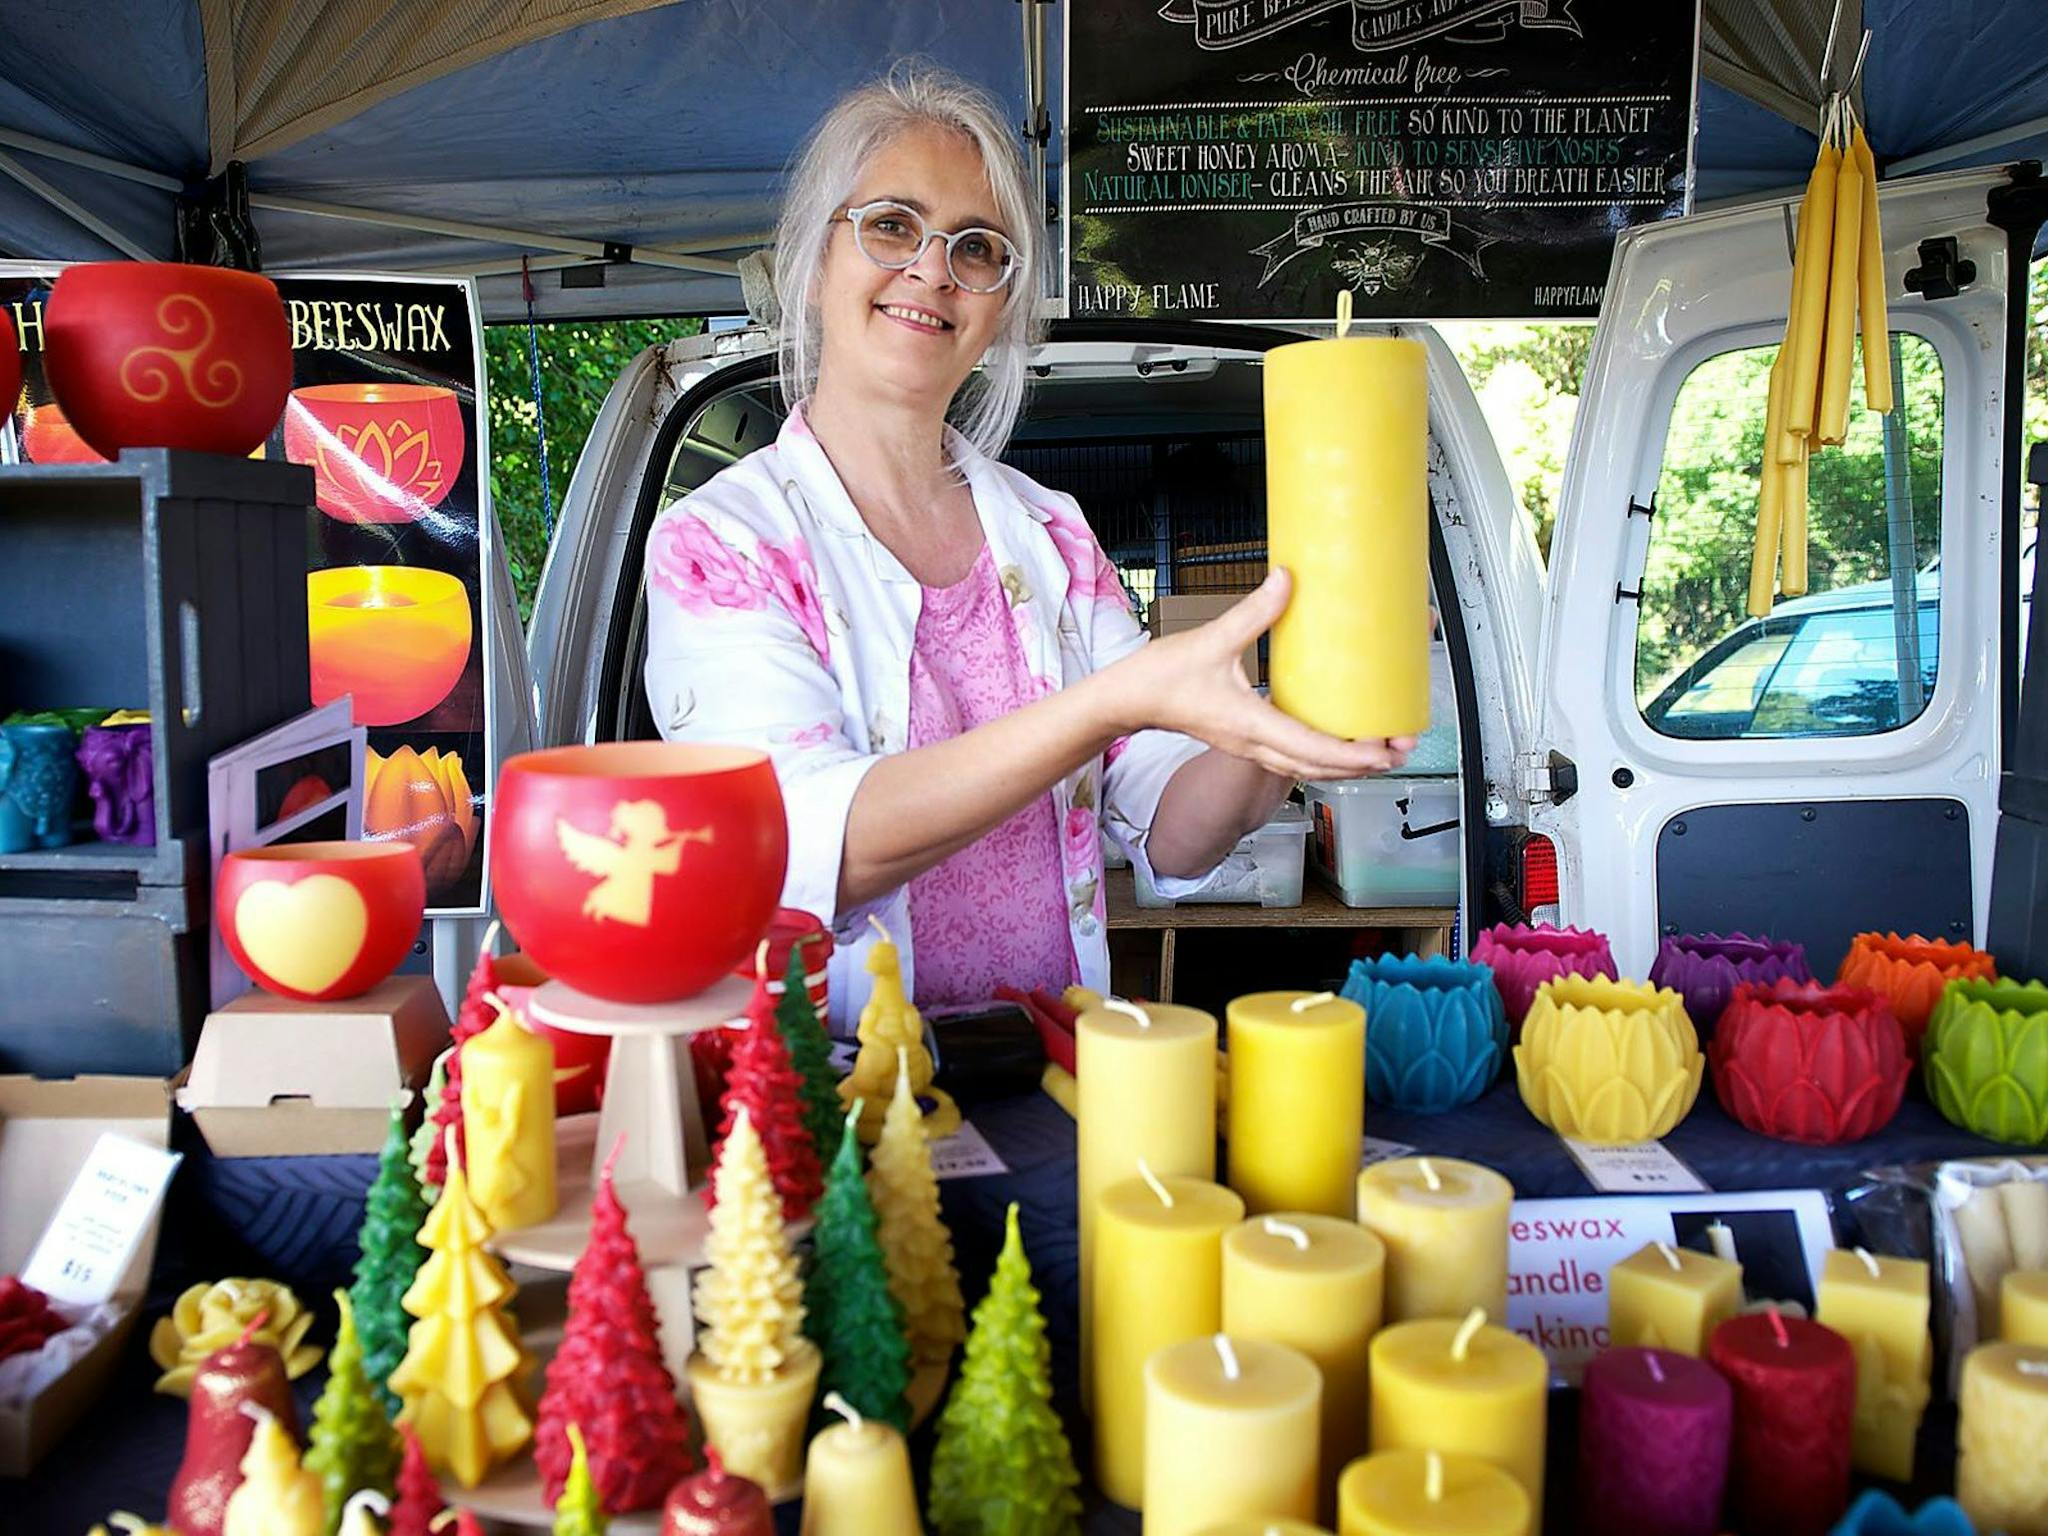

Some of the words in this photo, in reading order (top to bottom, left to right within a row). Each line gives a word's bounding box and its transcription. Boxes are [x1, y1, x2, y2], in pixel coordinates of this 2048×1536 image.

[1206, 1, 1256, 39] PURE
[1360, 2, 1423, 39] CANDLES
[1284, 52, 1409, 97] Chemical
[1414, 55, 1462, 93] free
[1097, 112, 1230, 143] SUSTAINABLE
[1356, 110, 1401, 137] FREE
[1407, 108, 1435, 136] SO
[1442, 107, 1490, 135] KIND
[1497, 108, 1523, 134] TO
[1531, 108, 1567, 134] THE
[1574, 105, 1655, 134] PLANET
[1127, 142, 1191, 172] SWEET
[1198, 142, 1259, 171] HONEY
[1356, 139, 1405, 166] KIND
[1413, 140, 1438, 165] TO
[1555, 137, 1620, 165] NOSES
[1084, 169, 1176, 202] NATURAL
[1270, 169, 1348, 197] CLEANS
[1355, 169, 1392, 196] THE
[1402, 169, 1434, 197] AIR
[1439, 168, 1466, 195] SO
[1473, 168, 1508, 196] YOU
[1514, 168, 1589, 196] BREATH
[1596, 166, 1666, 195] EASIER
[1306, 211, 1340, 233] HAND
[1344, 207, 1396, 225] CRAFTED
[1400, 209, 1418, 226] BY
[1420, 213, 1437, 230] US
[1078, 284, 1142, 312] HAPPY
[1152, 283, 1220, 310] FLAME
[1534, 286, 1604, 306] HAPPYFLAM
[291, 300, 452, 352] BEESWAX
[1510, 1219, 1626, 1242] eswax
[1508, 1259, 1604, 1296] andle
